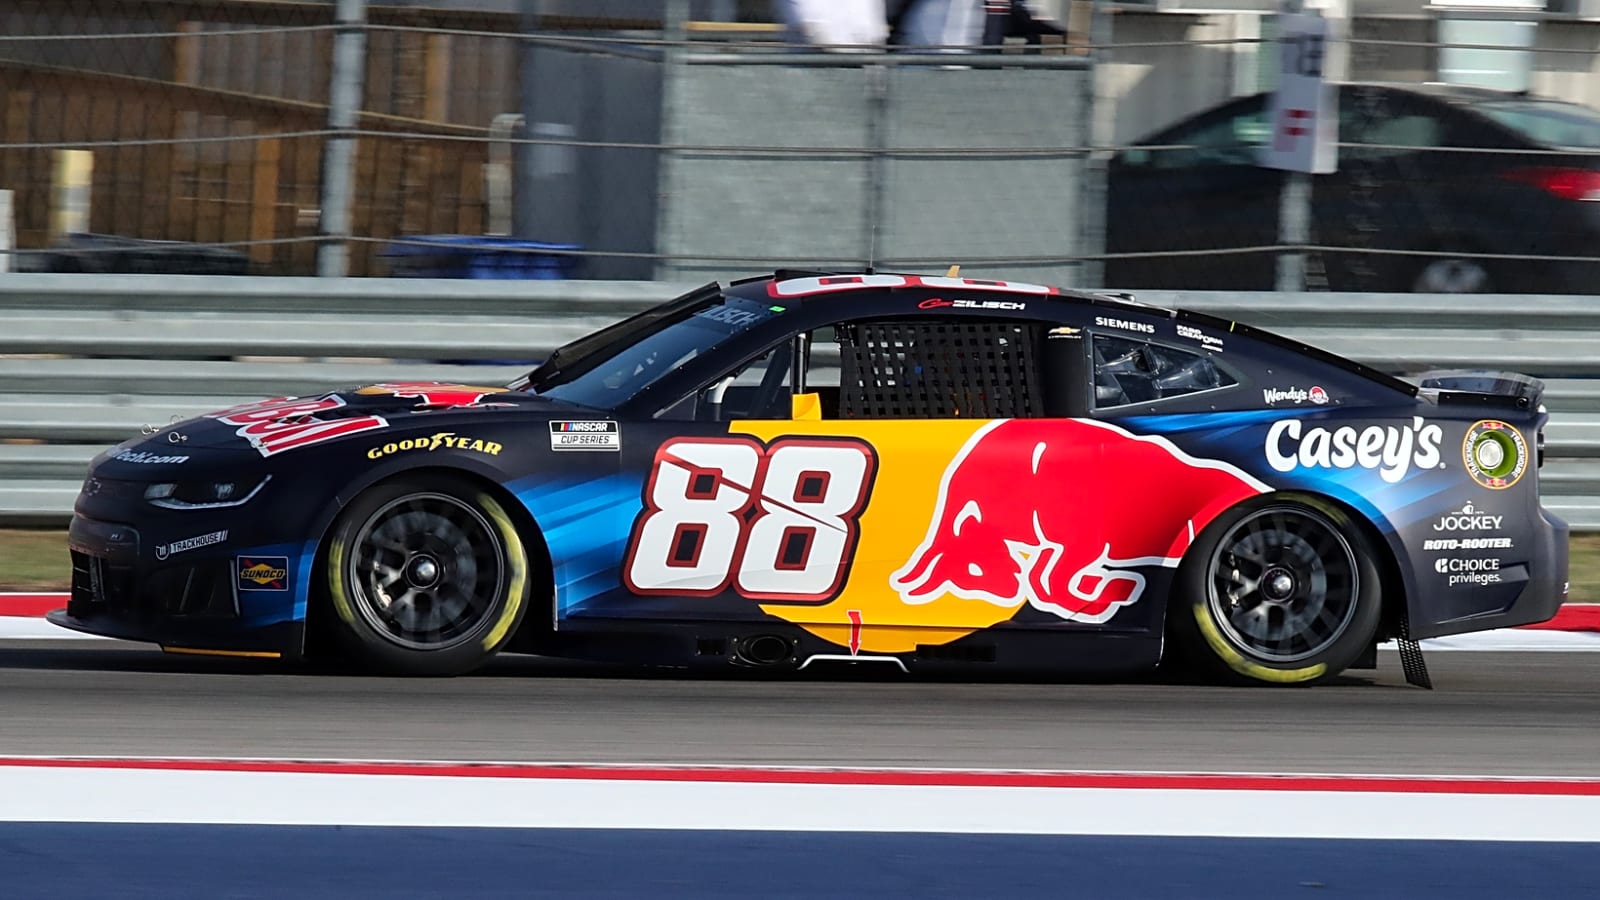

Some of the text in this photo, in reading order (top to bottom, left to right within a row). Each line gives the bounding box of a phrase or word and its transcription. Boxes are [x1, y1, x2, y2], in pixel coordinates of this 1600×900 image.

[952, 299, 1026, 310] ZILISCH
[1095, 316, 1155, 333] SIEMENS
[1263, 387, 1307, 404] Wendy's
[571, 422, 609, 432] NASCAR
[367, 432, 503, 459] GOODYEAR
[560, 435, 610, 444] CUP SERIES
[1265, 416, 1443, 483] Casey's
[623, 436, 877, 603] 88
[1433, 516, 1503, 531] JOCKEY
[173, 532, 219, 552] TRACKHOUSE
[1423, 538, 1512, 550] ROTO-ROOTER
[1449, 558, 1500, 571] CHOICE
[241, 568, 285, 579] SUNOCO
[1449, 572, 1501, 587] privileges
